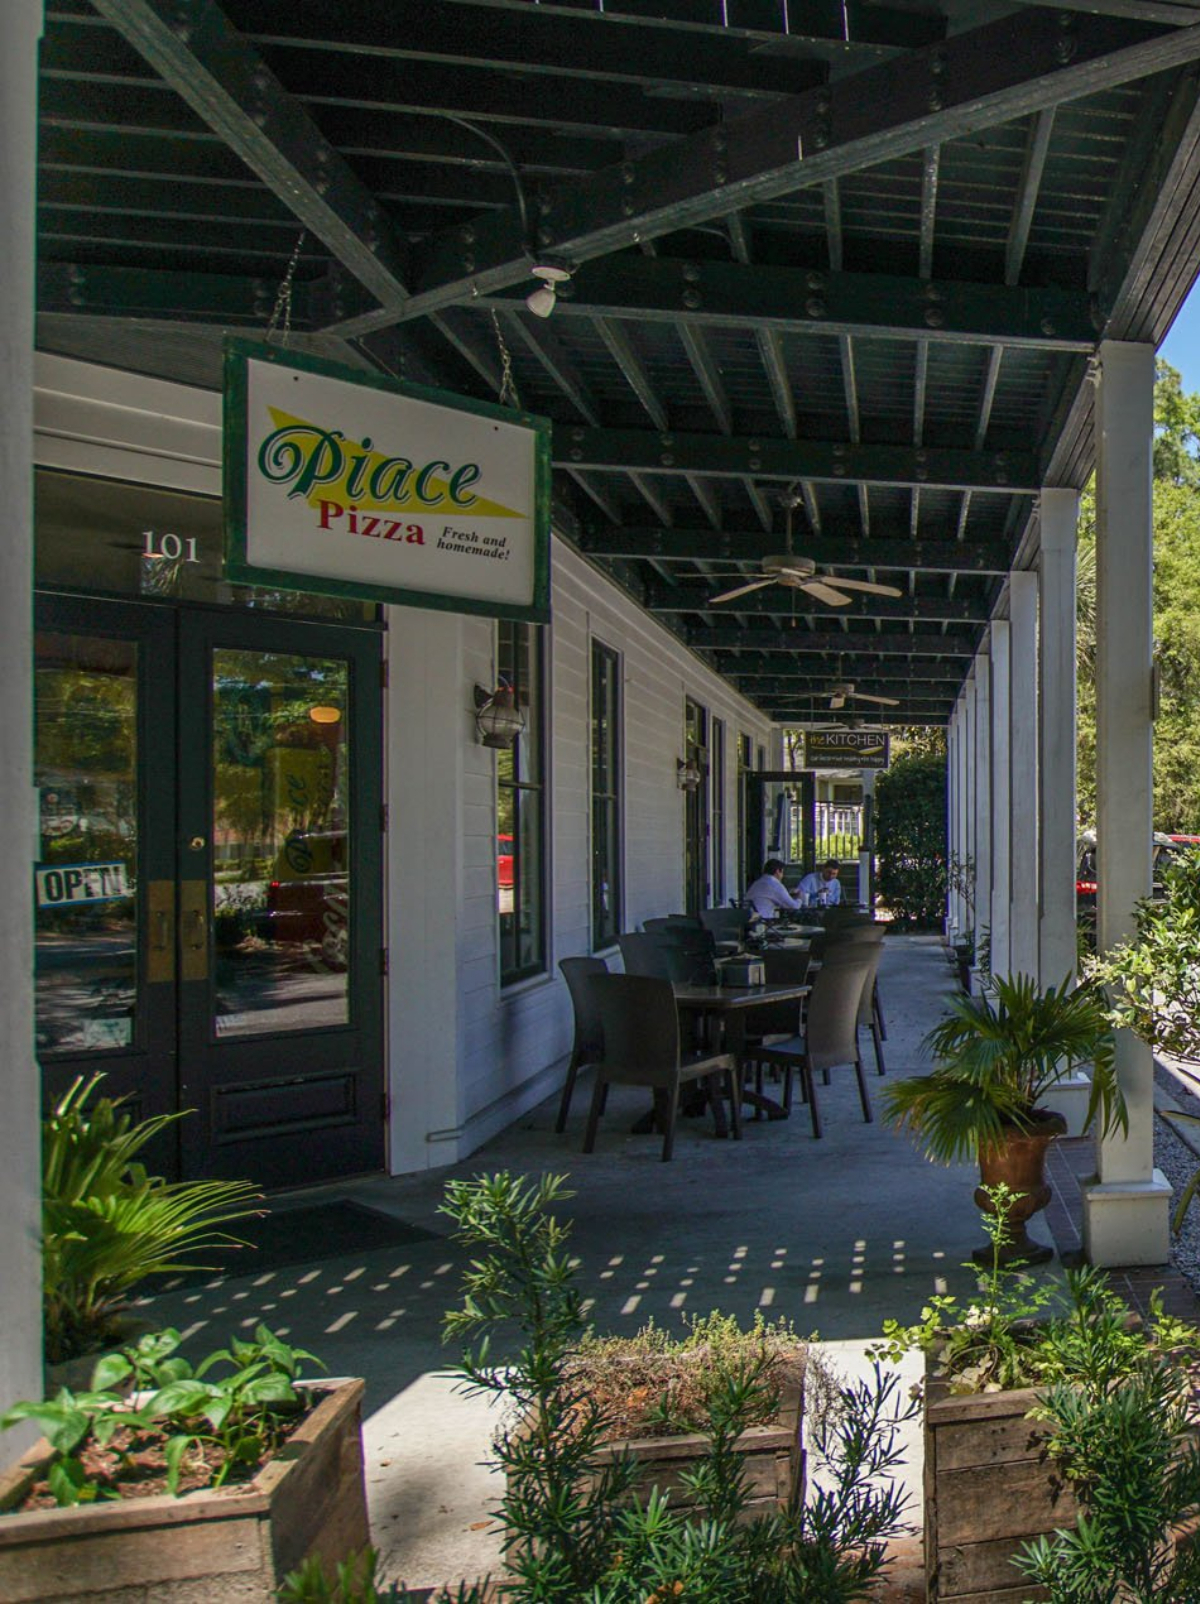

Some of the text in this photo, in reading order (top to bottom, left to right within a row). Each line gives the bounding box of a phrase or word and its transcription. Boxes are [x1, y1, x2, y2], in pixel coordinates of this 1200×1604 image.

[258, 424, 481, 507] Piace
[316, 499, 426, 546] Pizza
[442, 526, 507, 548] Fresh and
[142, 531, 200, 563] 101
[436, 537, 510, 561] homemade!
[44, 865, 122, 902] OPEN
